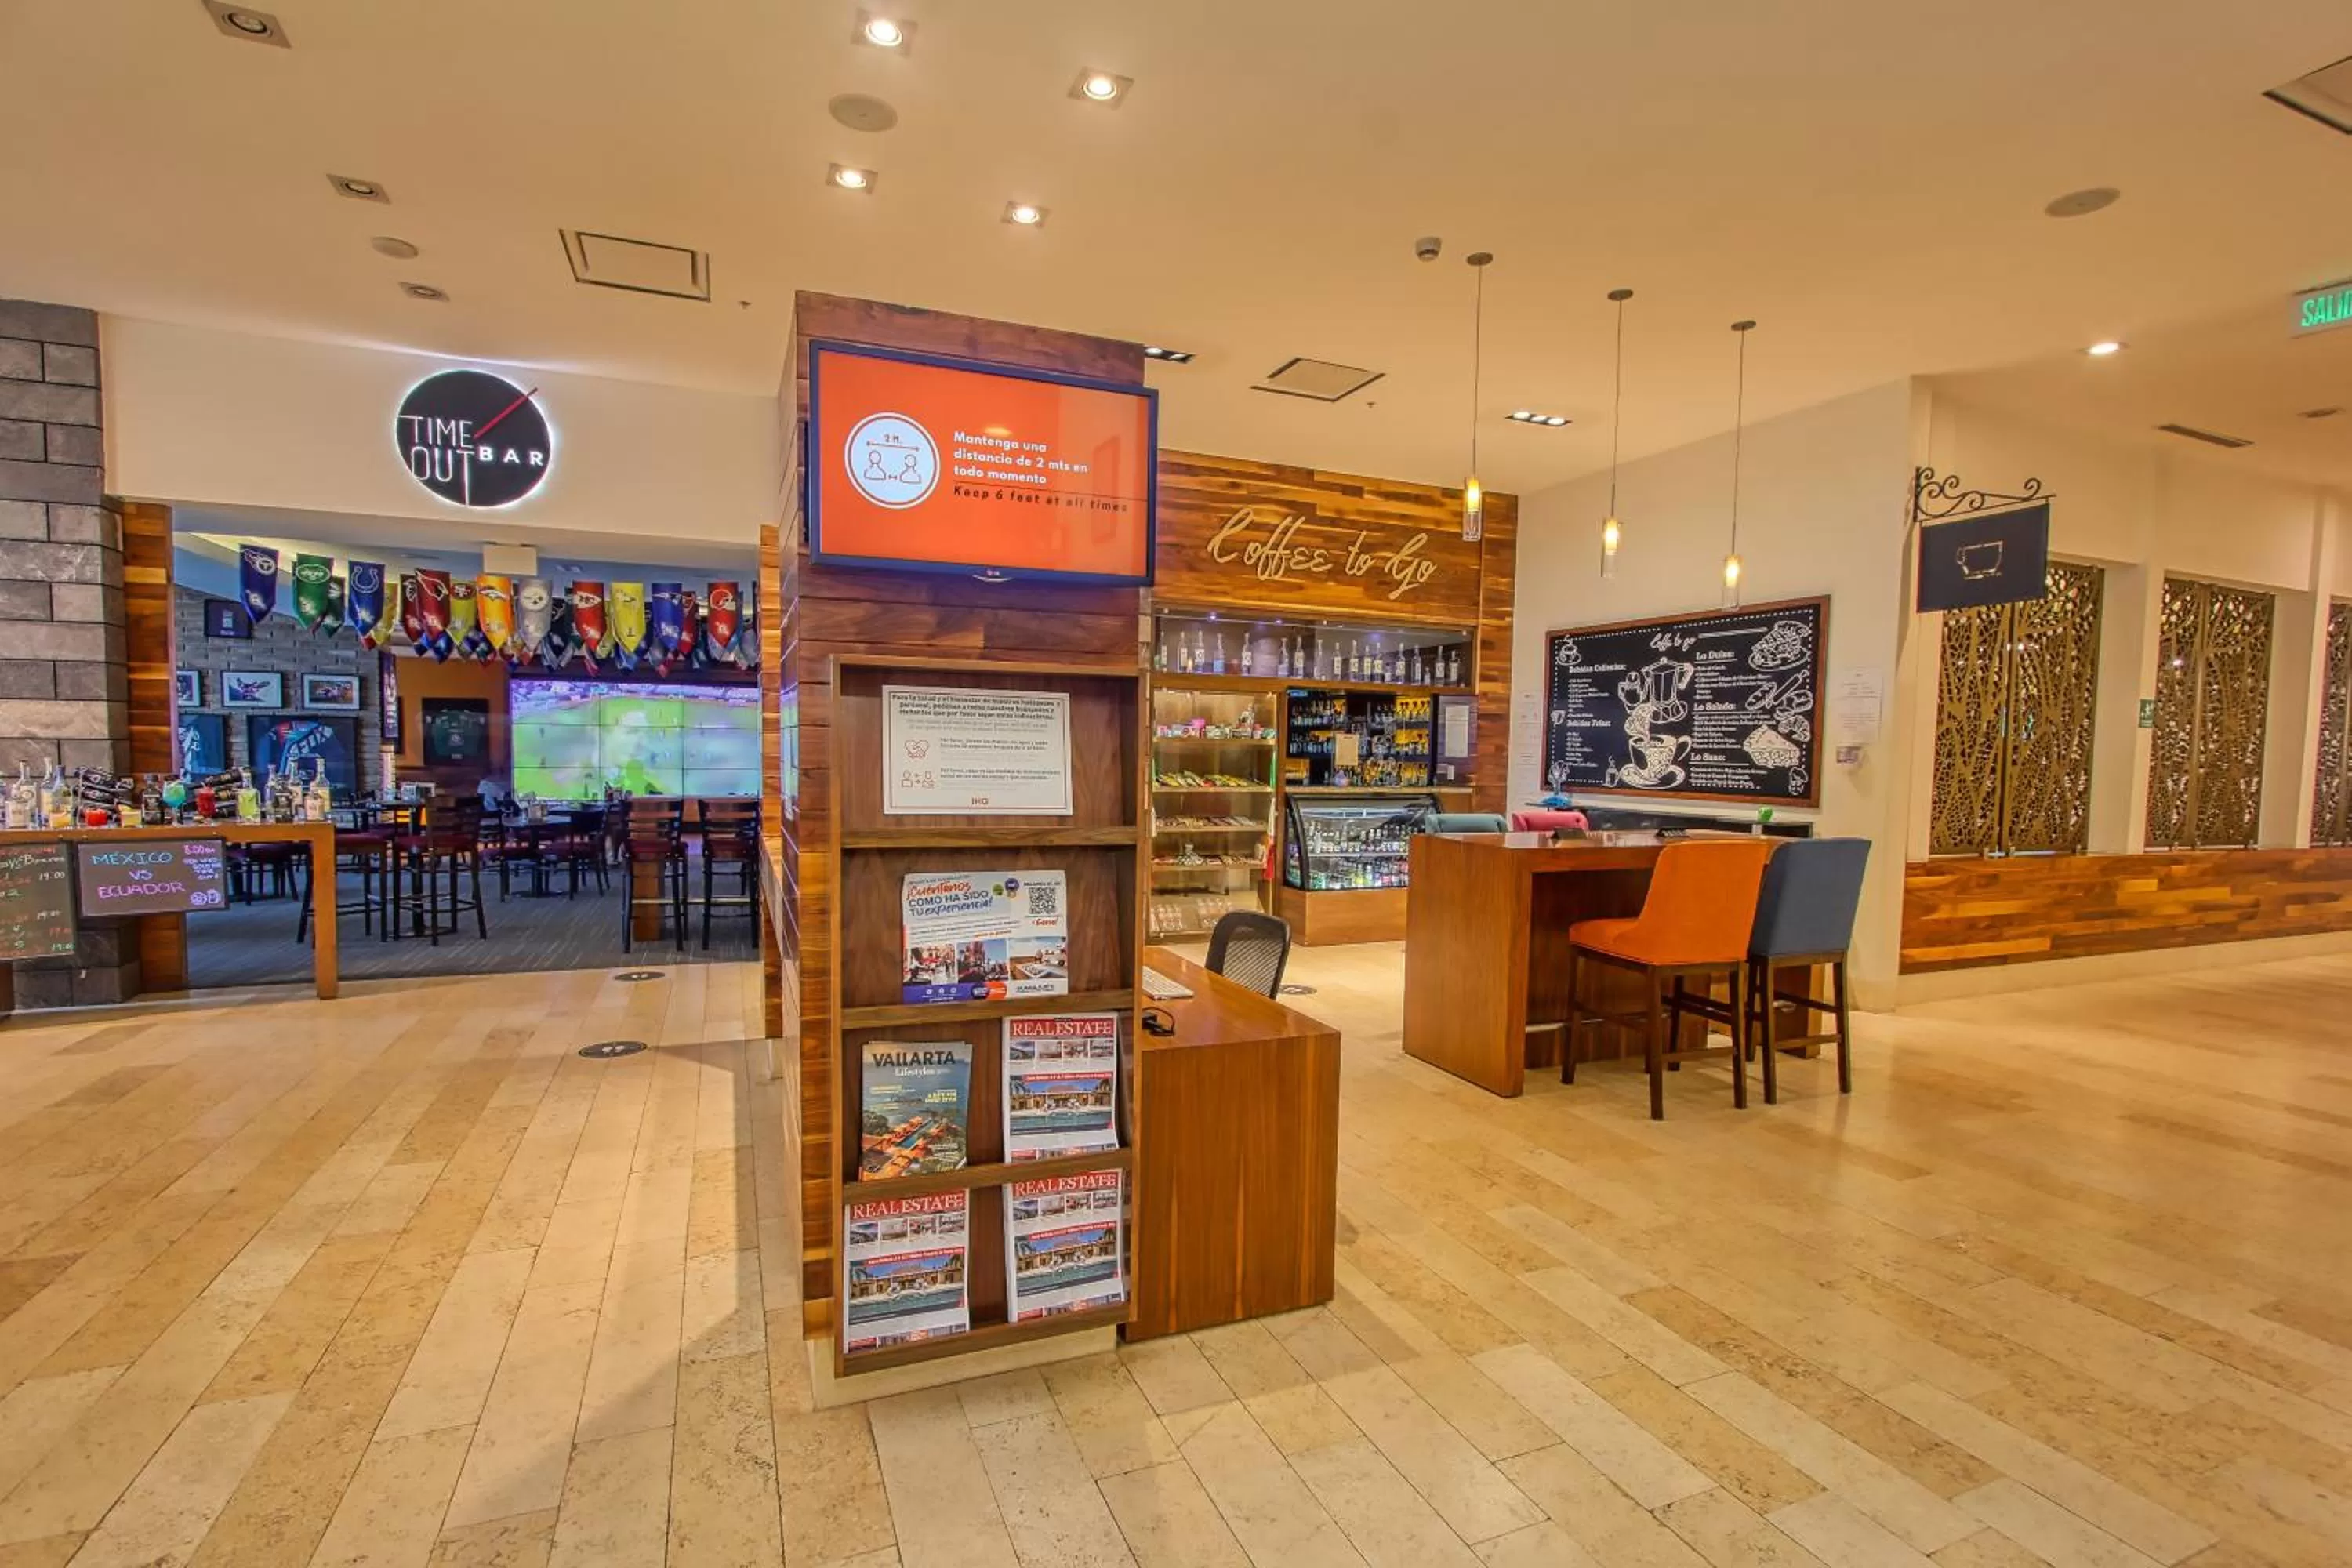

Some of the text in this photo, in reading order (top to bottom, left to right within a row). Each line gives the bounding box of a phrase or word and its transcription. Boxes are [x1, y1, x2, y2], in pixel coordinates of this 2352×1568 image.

[397, 415, 474, 448] TIME
[953, 431, 1047, 452] Mantenga una
[479, 445, 544, 466] BAR
[953, 448, 1089, 474] distancia de 2 mts en
[410, 445, 475, 506] OUT
[953, 465, 1047, 485] todo momento
[953, 485, 989, 500] Keep
[996, 492, 1004, 500] 6
[1010, 492, 1040, 504] feet
[1046, 496, 1060, 506] at
[1207, 507, 1437, 601] Coffee to Go
[97, 881, 186, 899] ECUADOR
[945, 893, 960, 903] HA
[964, 890, 989, 901] SIDO
[872, 1051, 956, 1068] VALLARTA
